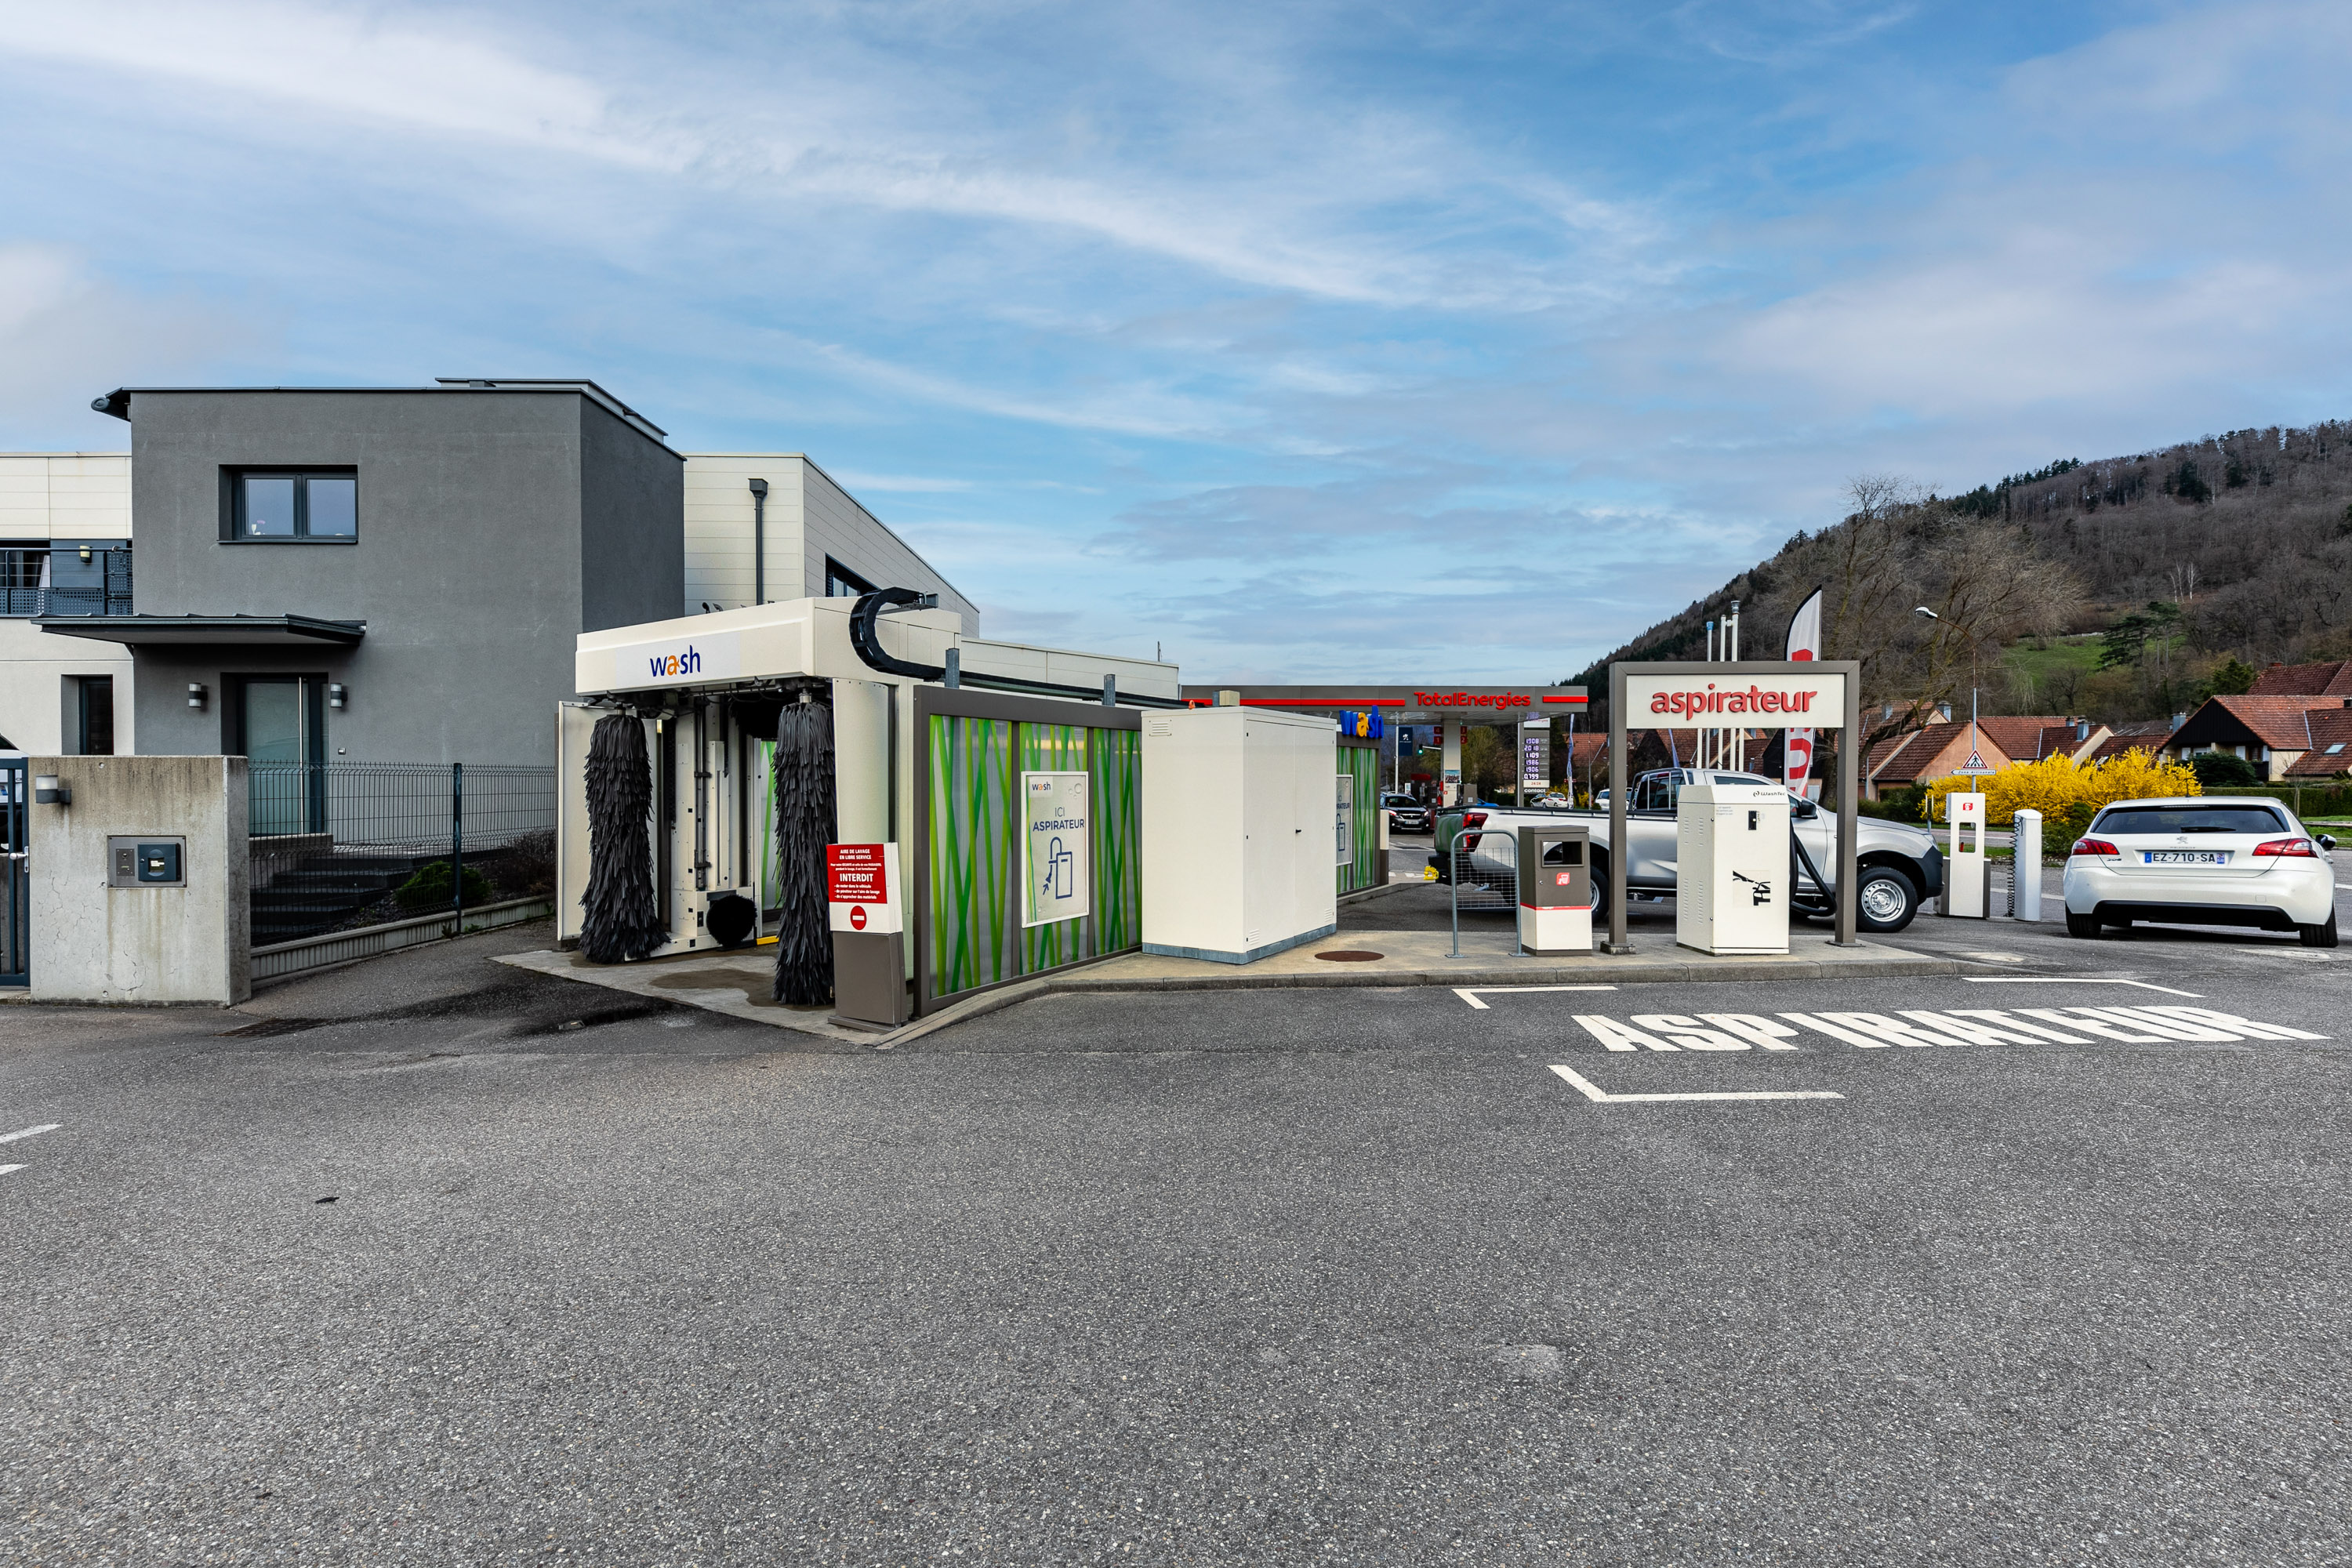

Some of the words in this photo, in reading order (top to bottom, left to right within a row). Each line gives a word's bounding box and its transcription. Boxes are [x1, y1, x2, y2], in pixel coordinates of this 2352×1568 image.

[649, 644, 701, 677] wash
[1414, 691, 1531, 710] TotalEnergies
[1650, 683, 1818, 721] aspirateur
[1339, 705, 1385, 739] wash
[1033, 781, 1051, 790] wash
[1054, 807, 1065, 817] ICI
[1033, 819, 1084, 831] ASPIRATEUR
[2153, 853, 2215, 862] EZ-710-SA
[840, 873, 873, 882] INTERDIT
[1570, 1006, 2334, 1052] ASPIRATEUR
